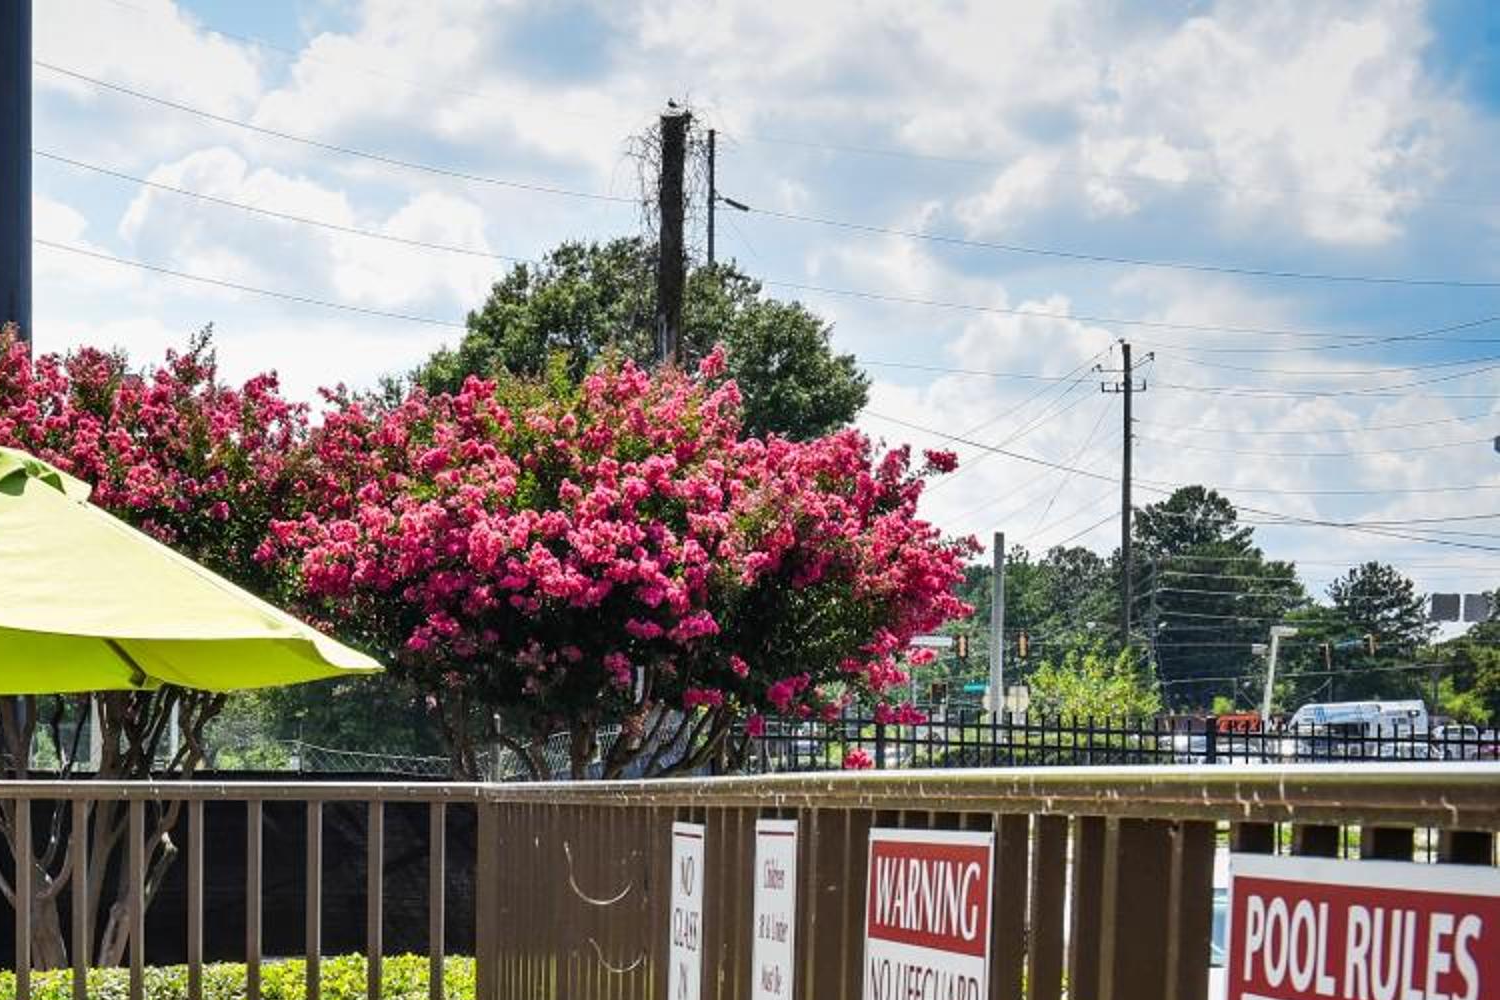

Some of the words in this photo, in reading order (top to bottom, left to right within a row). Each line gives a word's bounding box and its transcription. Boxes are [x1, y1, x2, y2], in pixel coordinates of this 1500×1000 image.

[680, 856, 695, 896] NO
[872, 855, 981, 941] WARNING
[1243, 896, 1336, 995] POOL
